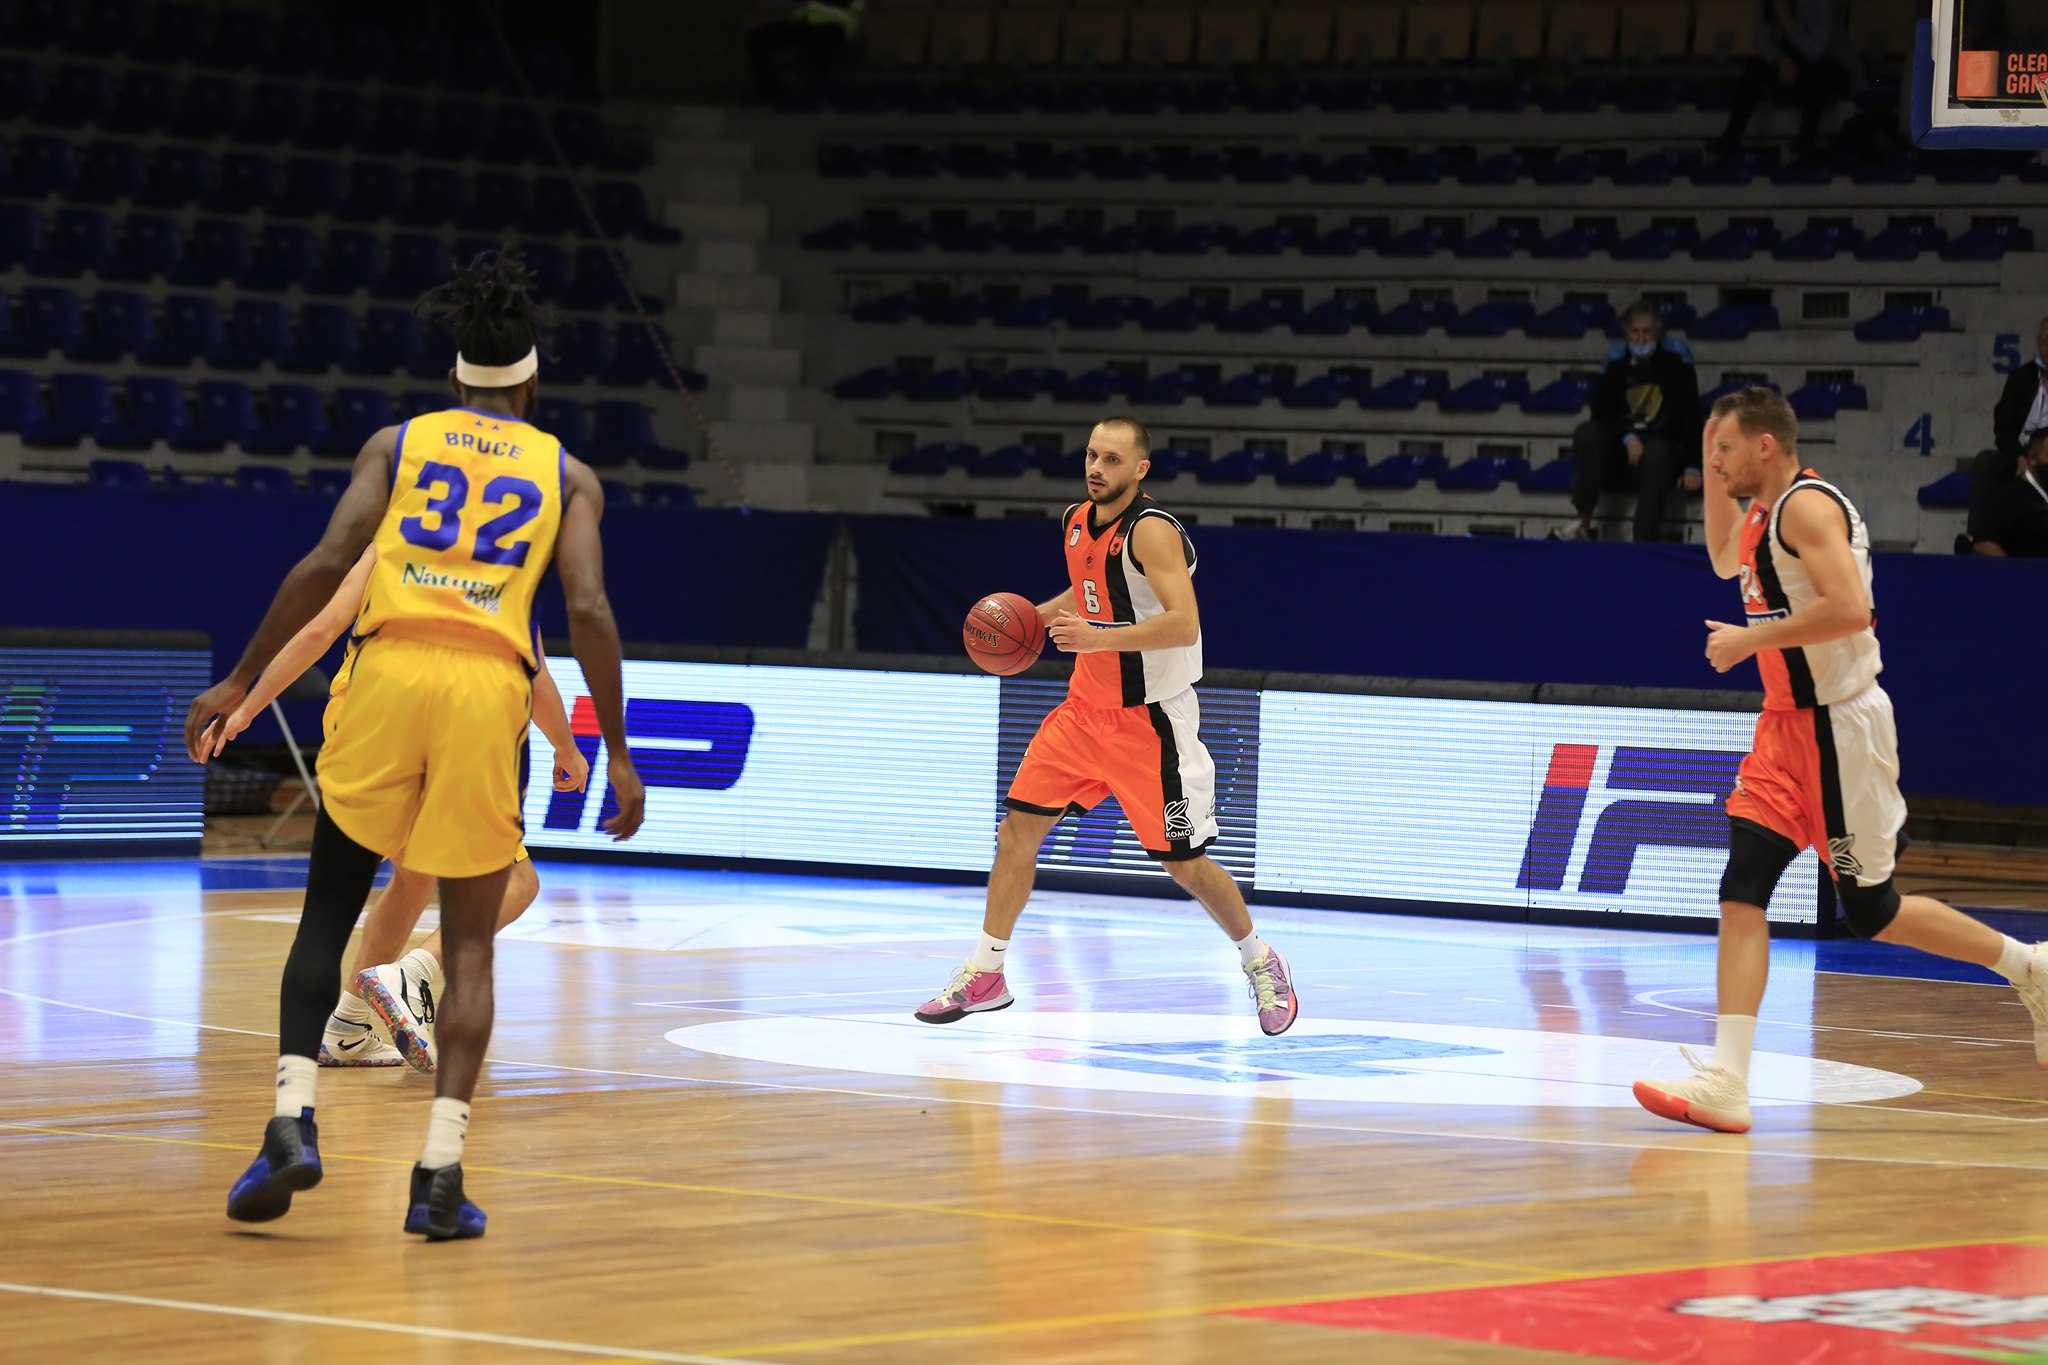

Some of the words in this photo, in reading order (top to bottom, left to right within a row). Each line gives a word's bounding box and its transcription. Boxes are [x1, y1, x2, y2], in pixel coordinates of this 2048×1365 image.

[1991, 333, 2022, 374] 5
[446, 432, 523, 459] BRUCE
[1903, 412, 1936, 457] 4
[399, 461, 543, 568] 32
[402, 562, 506, 599] Natural
[1082, 578, 1101, 614] 6
[1165, 828, 1195, 838] KOMOT
